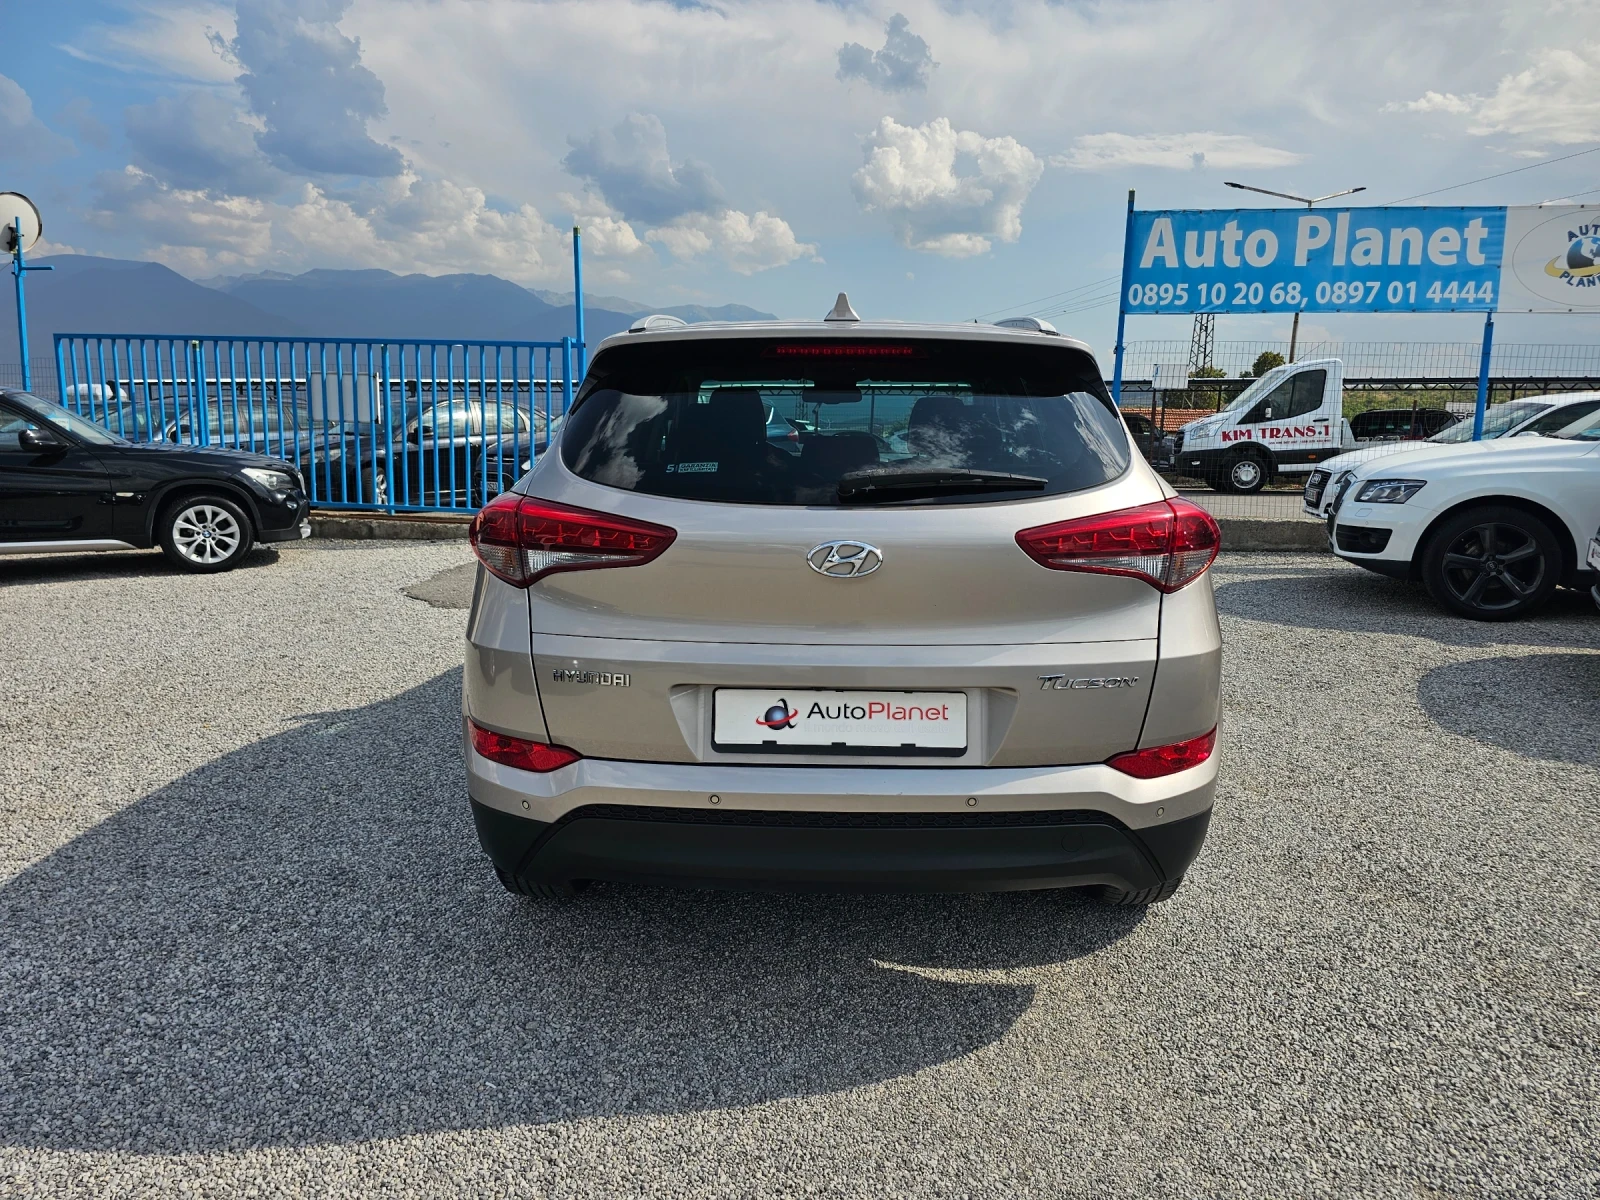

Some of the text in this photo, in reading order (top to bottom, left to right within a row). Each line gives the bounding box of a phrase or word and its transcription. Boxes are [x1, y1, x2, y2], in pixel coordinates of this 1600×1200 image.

[1139, 212, 1488, 269] Auto Planet
[1128, 281, 1494, 307] 0895 10 20 68, 0897 01 4444
[1222, 428, 1252, 442] KIM
[553, 669, 631, 687] HYUNDAI
